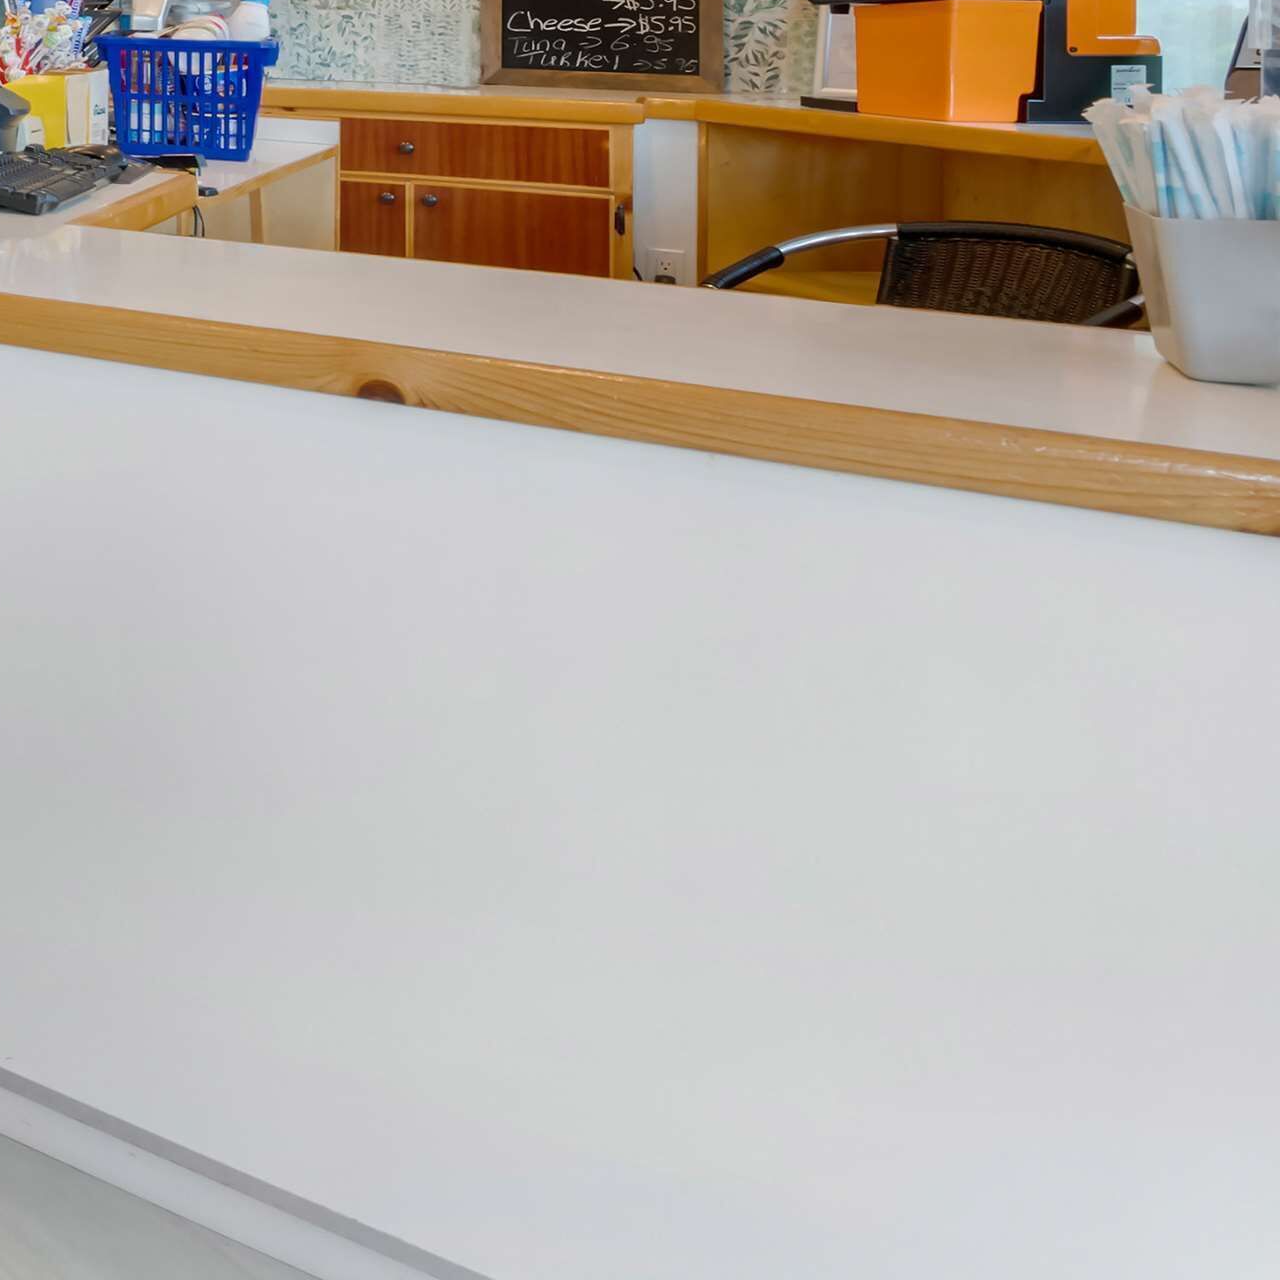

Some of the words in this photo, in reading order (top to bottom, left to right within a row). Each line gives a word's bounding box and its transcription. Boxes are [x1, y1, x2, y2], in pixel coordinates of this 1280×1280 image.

[507, 11, 602, 32] Cheese
[636, 14, 696, 35] $5.95
[508, 35, 566, 54] Tuna
